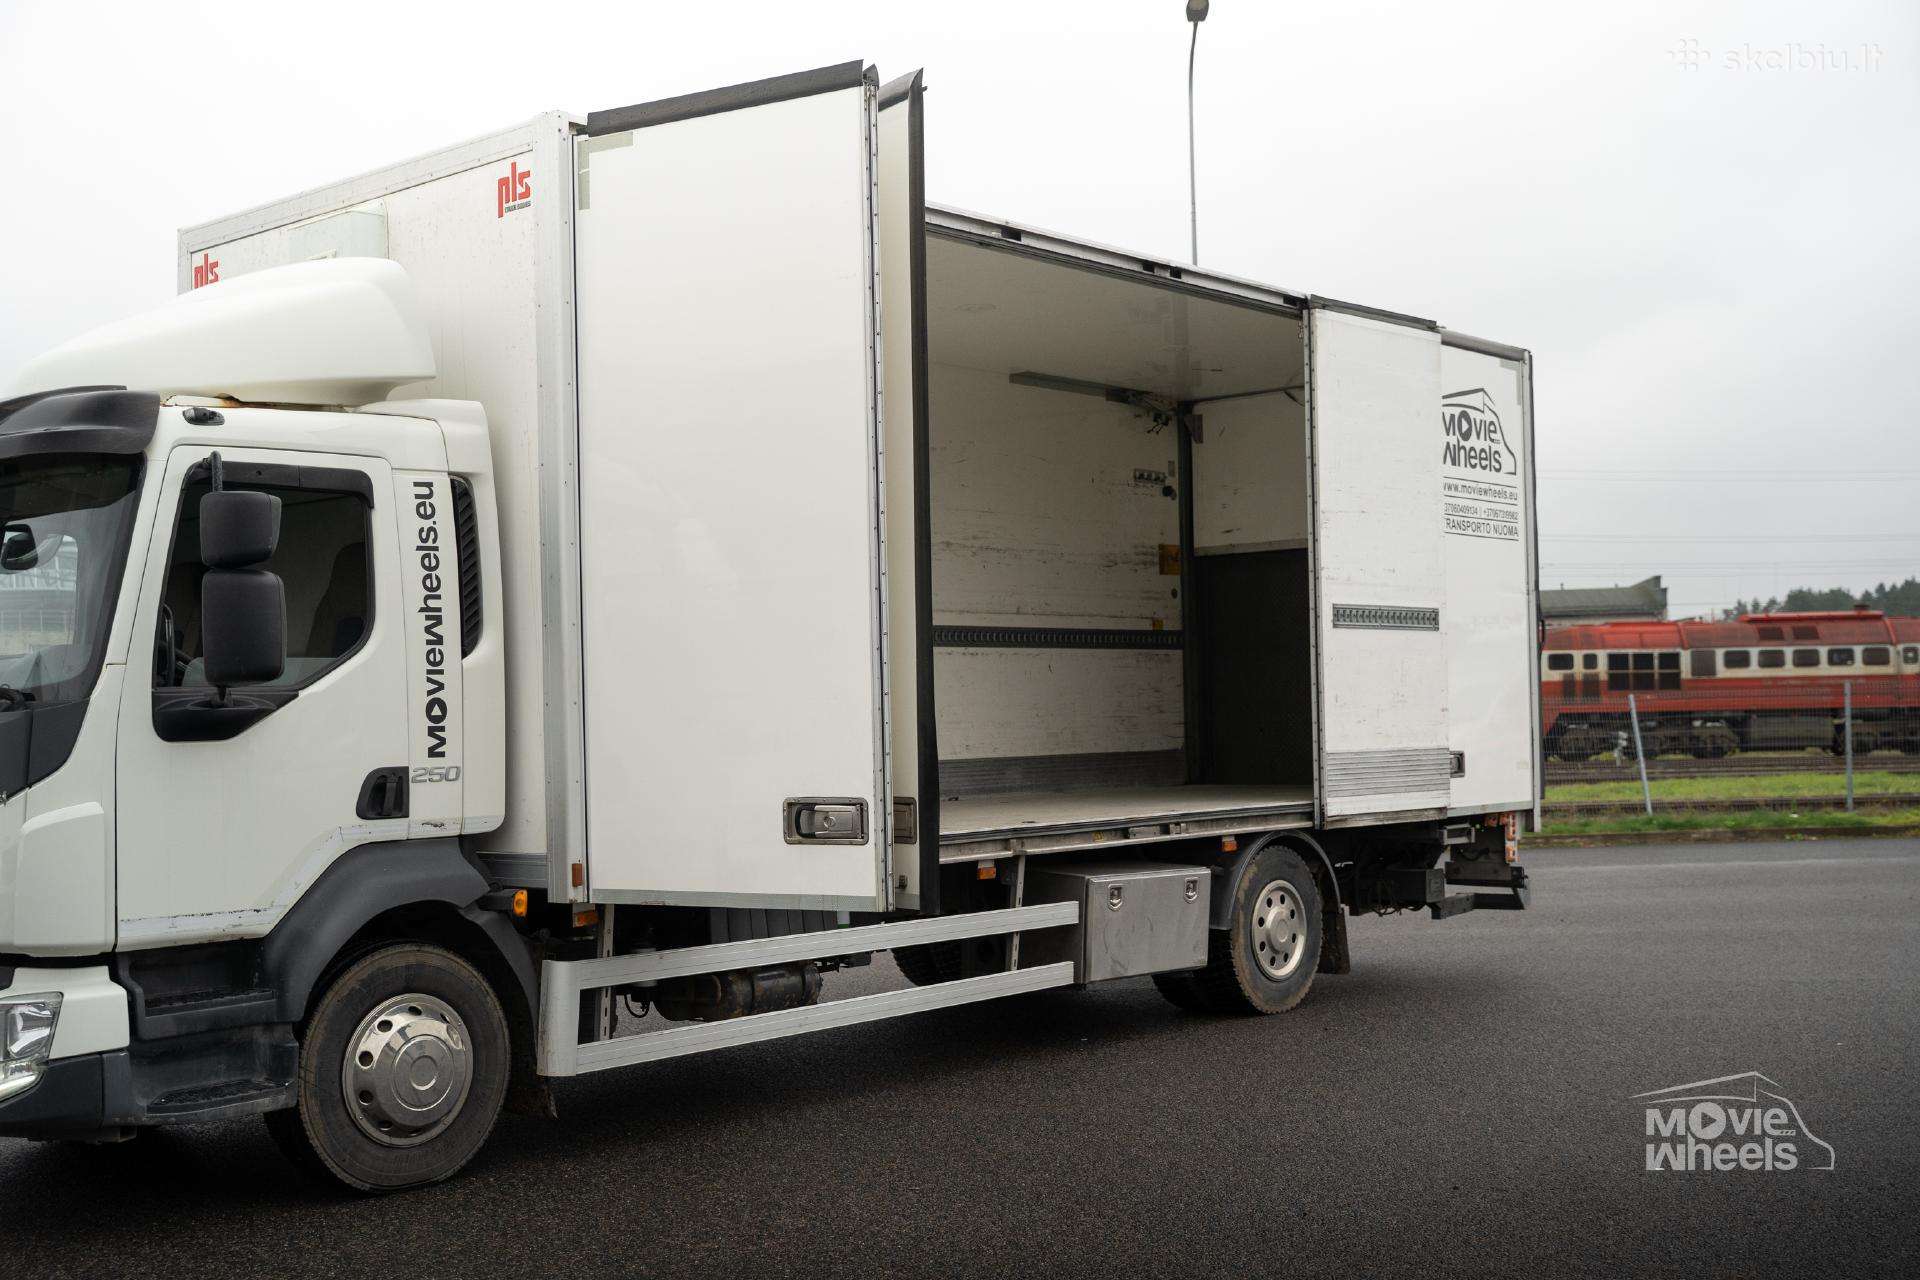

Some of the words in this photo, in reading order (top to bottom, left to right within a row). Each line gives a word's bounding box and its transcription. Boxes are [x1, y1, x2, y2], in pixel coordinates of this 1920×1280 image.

[1444, 518, 1491, 534] RANSPORTO
[1493, 523, 1519, 537] NUOMA
[411, 766, 461, 783] 250
